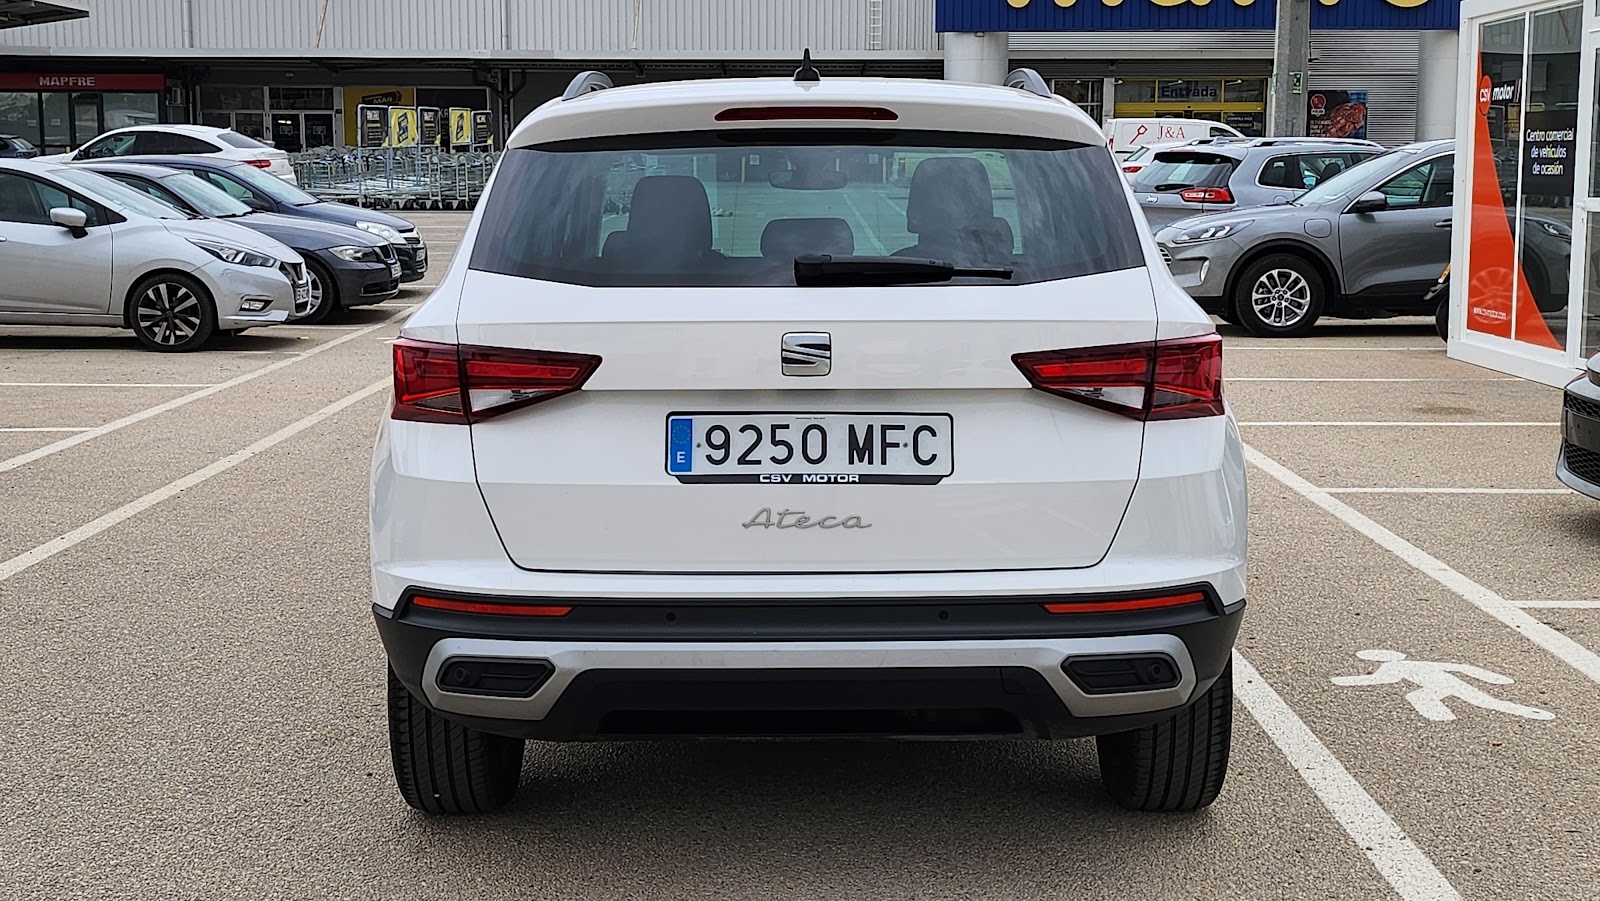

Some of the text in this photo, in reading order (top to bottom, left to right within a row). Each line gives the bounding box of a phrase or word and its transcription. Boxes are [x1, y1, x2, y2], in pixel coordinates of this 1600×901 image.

[39, 76, 95, 86] MAPFRE
[1161, 85, 1218, 98] Entrada
[1492, 84, 1515, 101] motor
[1157, 125, 1186, 140] J&A
[1526, 127, 1575, 142] Centro comercial
[1530, 144, 1567, 158] de vehículos
[1532, 161, 1564, 175] de ocasión
[704, 423, 938, 466] 9250 MFC
[676, 451, 686, 463] E
[759, 473, 860, 483] CSV MOTOR
[741, 507, 873, 530] Ateca
